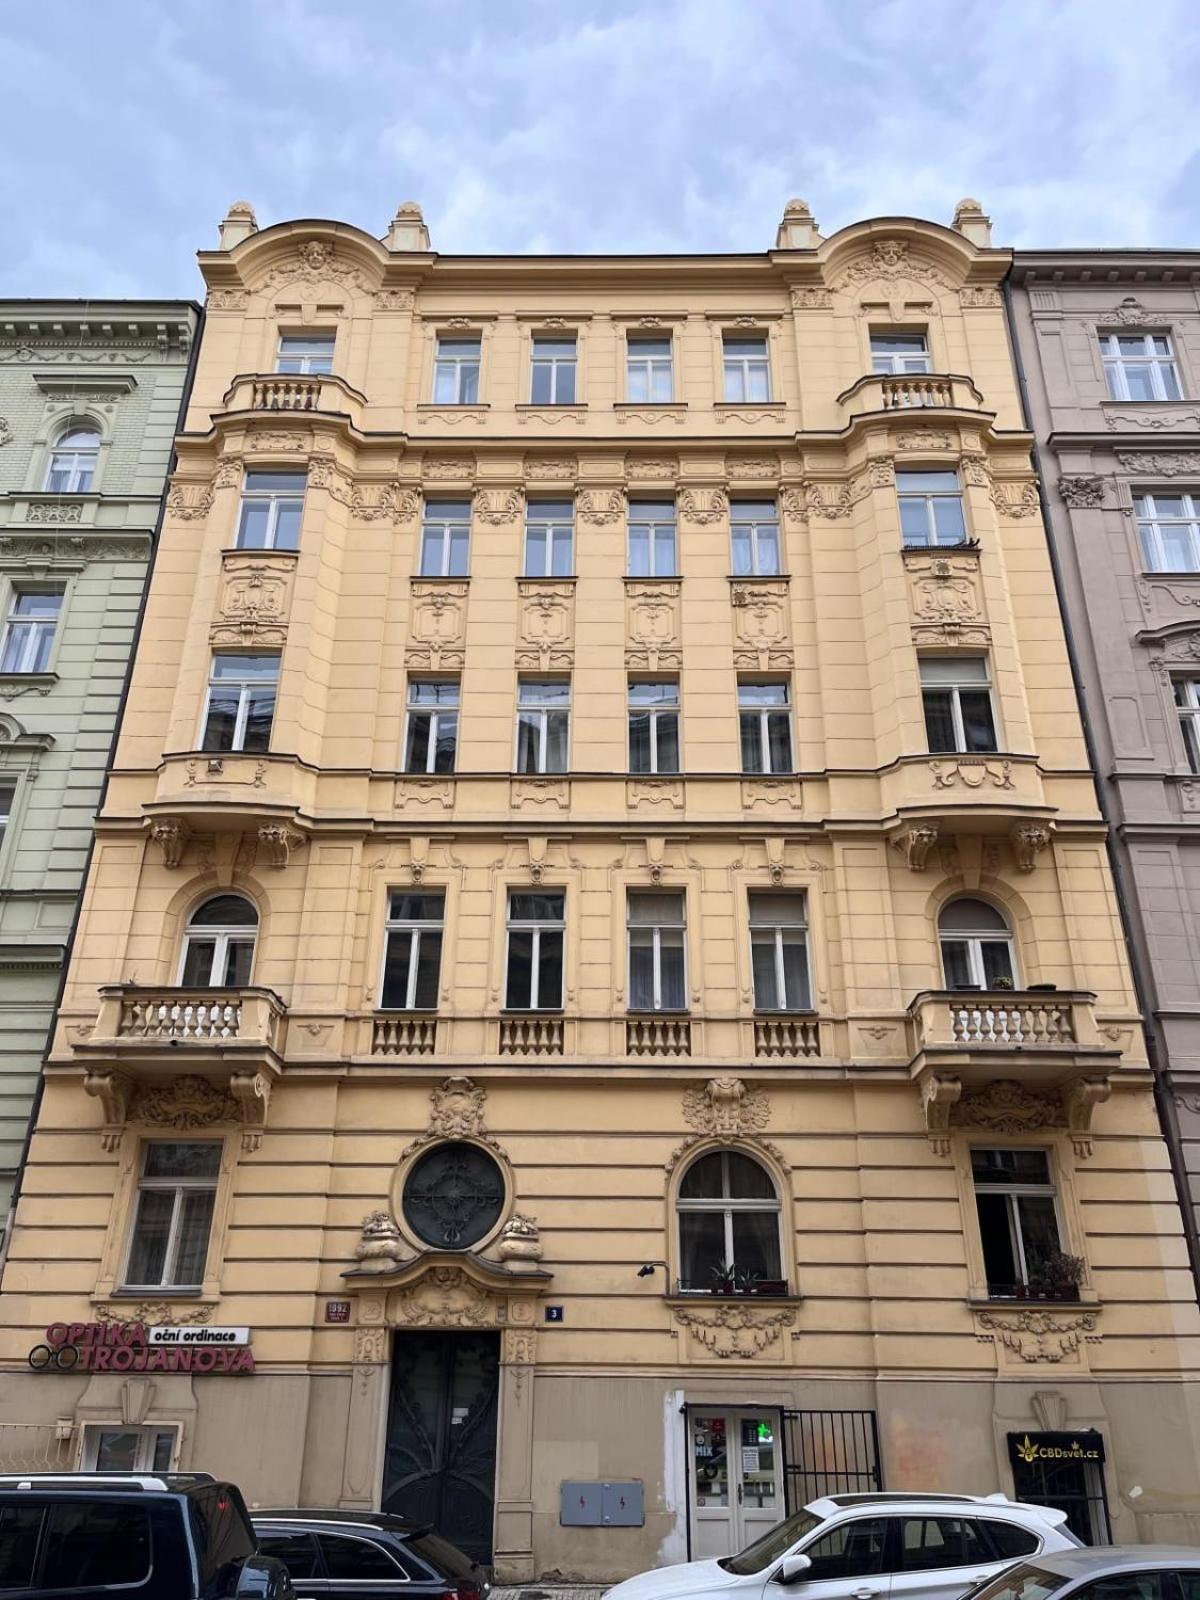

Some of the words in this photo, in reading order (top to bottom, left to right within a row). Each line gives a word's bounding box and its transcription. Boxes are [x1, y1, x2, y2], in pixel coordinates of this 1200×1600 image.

[550, 1309, 557, 1319] 3
[46, 1322, 148, 1347] OPTIKA
[154, 1329, 181, 1341] oční
[183, 1329, 236, 1341] ordinace
[79, 1346, 255, 1371] TROJANOVA
